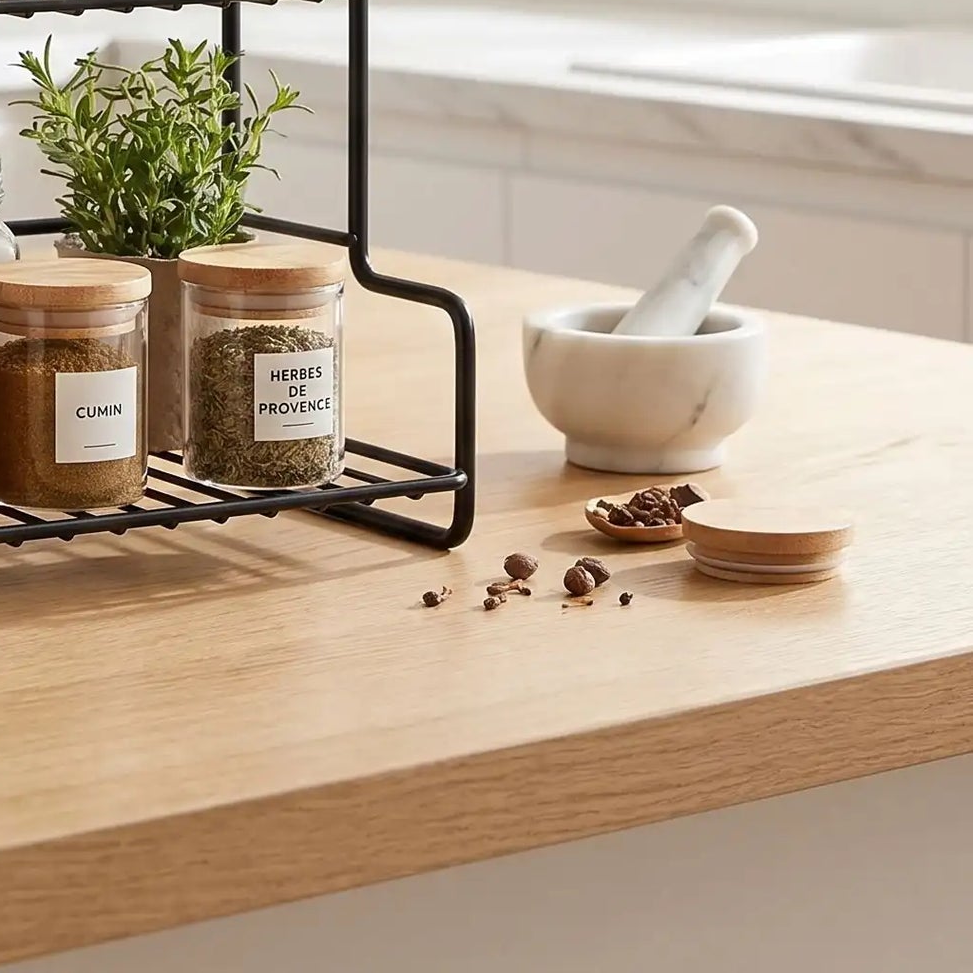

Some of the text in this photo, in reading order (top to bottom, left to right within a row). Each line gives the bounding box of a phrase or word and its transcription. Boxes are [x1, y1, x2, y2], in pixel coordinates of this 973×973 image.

[270, 366, 323, 382] HERBES
[288, 384, 307, 398] DE
[75, 403, 122, 419] CUMIN
[258, 397, 331, 415] PROVENCE
